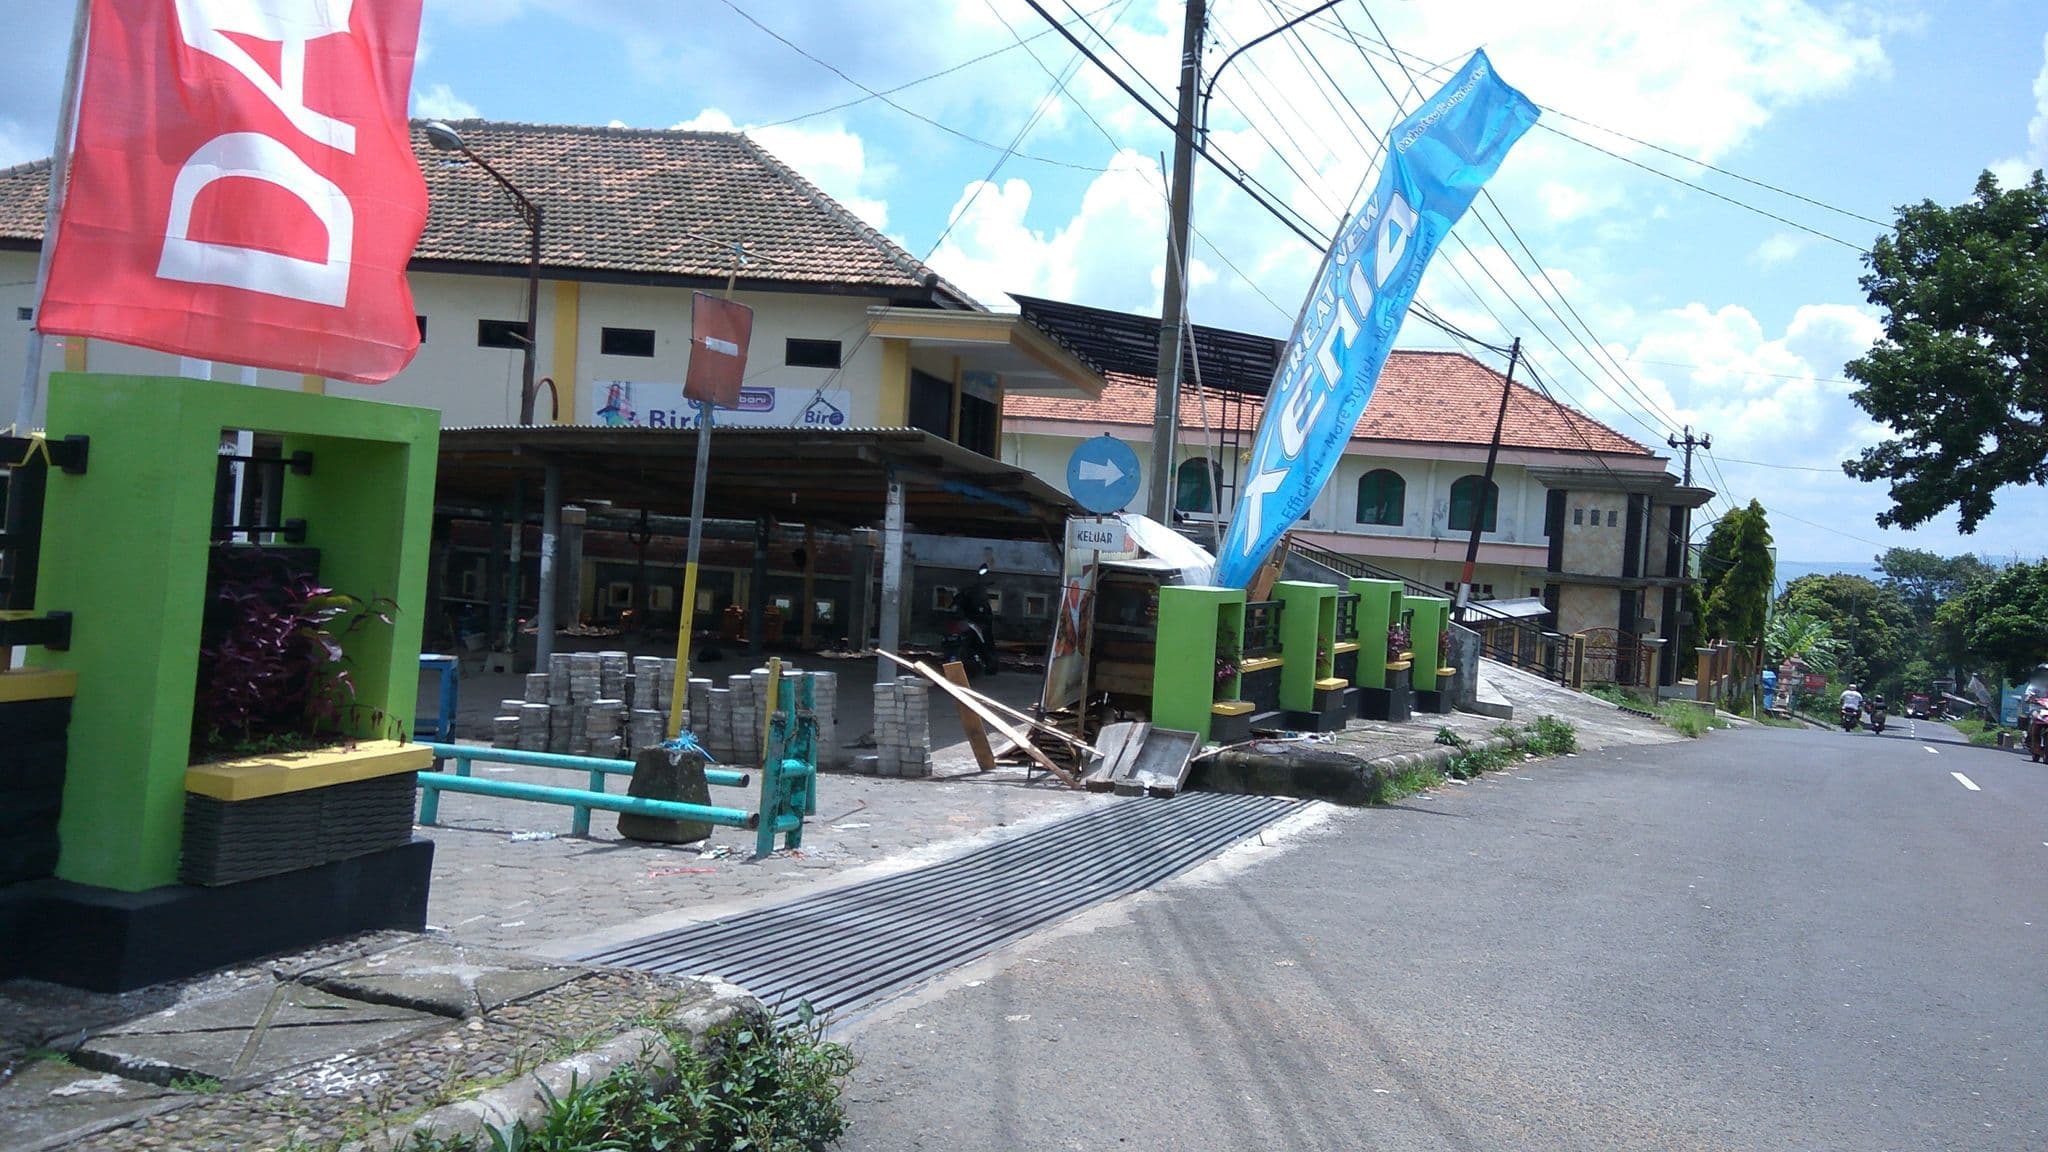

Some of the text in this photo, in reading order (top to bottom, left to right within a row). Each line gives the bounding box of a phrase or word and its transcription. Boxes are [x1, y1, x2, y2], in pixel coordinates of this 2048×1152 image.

[1281, 194, 1379, 392] GREAT NEW
[1282, 461, 1322, 519] Efficient
[1324, 409, 1351, 449] More
[1345, 354, 1377, 407] Stylish
[1077, 530, 1113, 544] KELUAR
